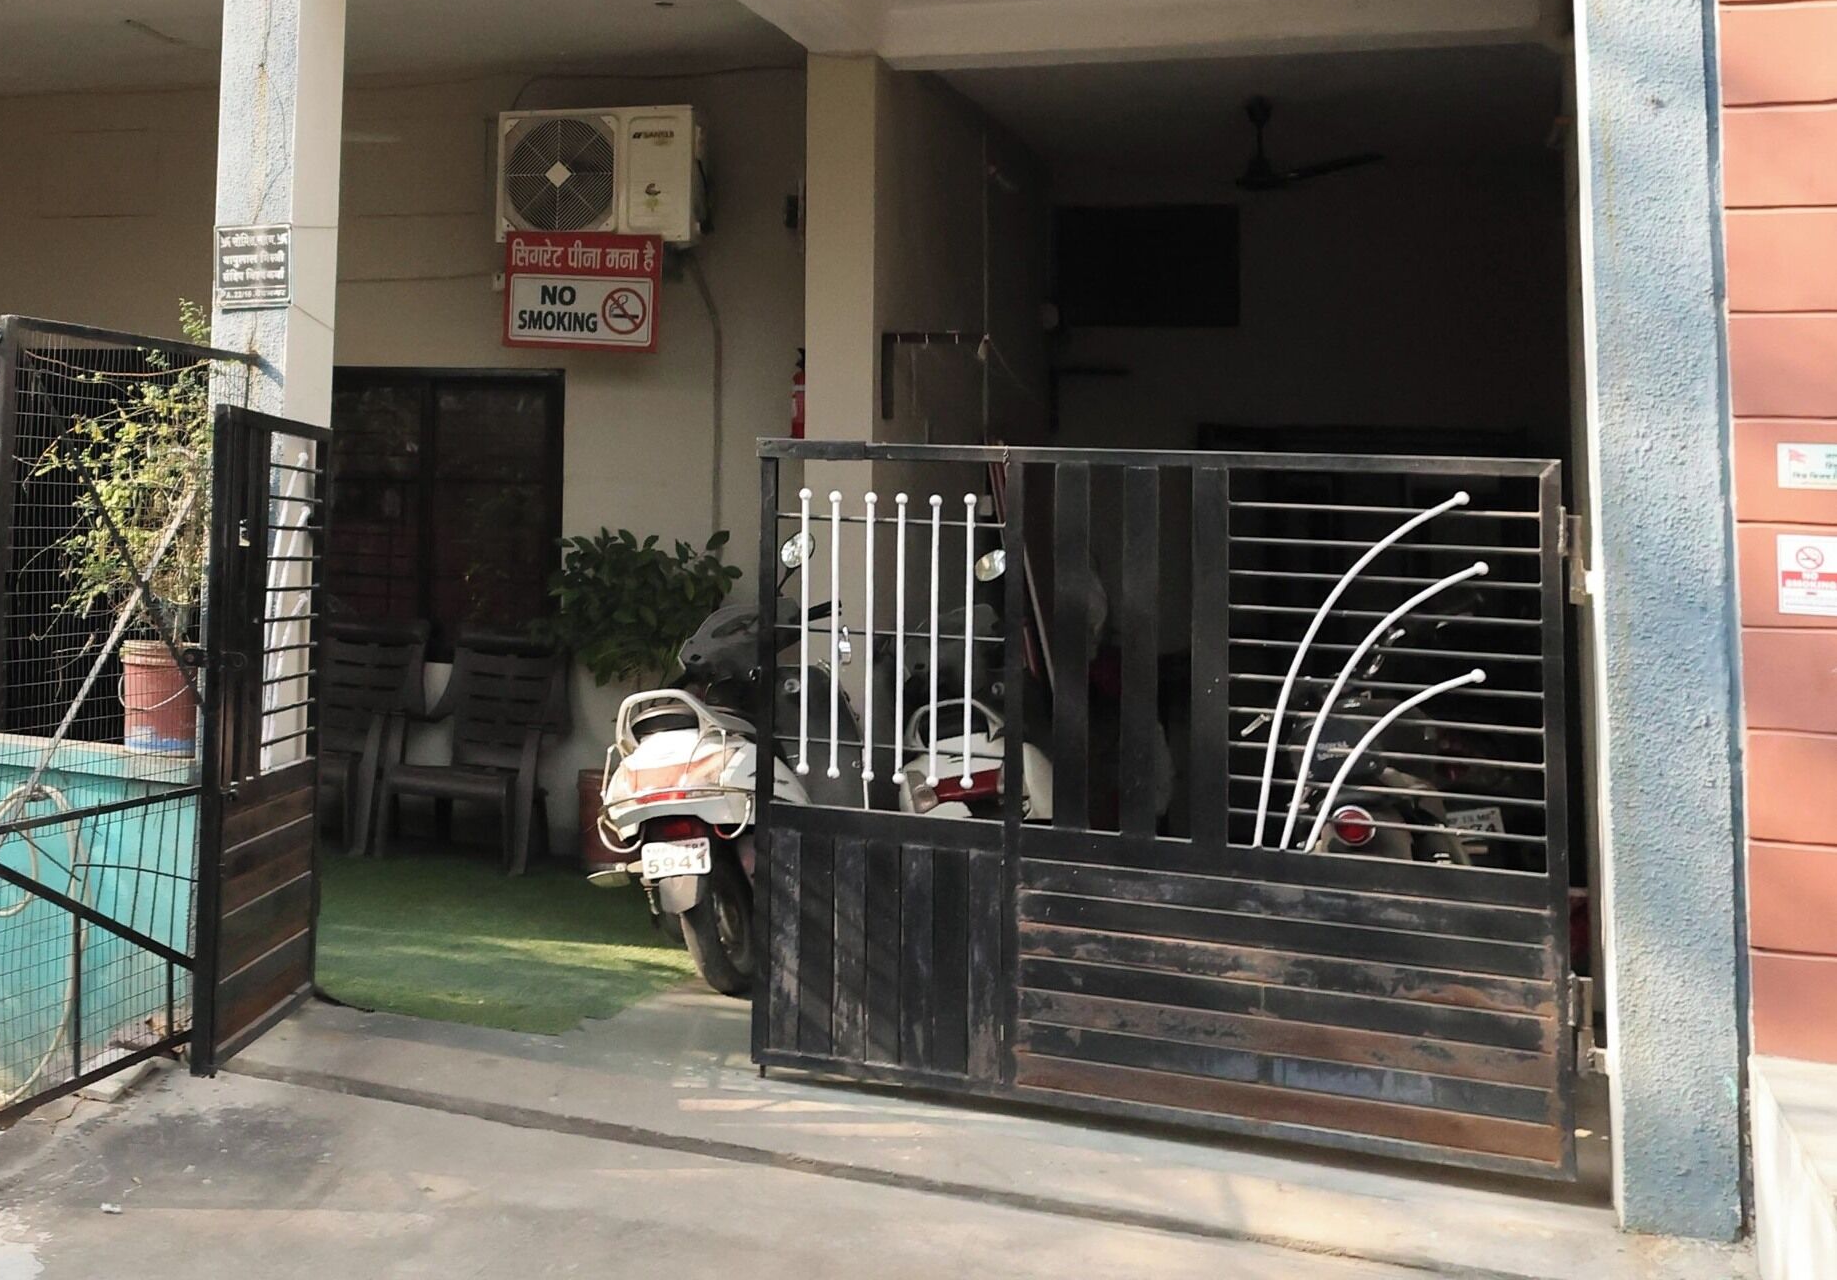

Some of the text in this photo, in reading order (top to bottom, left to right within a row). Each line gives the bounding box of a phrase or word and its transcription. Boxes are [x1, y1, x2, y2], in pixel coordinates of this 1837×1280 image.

[512, 239, 656, 272] सिगरेट पीना मना है
[540, 285, 576, 306] NO
[518, 309, 598, 334] SMOKING
[648, 851, 708, 874] 5941
